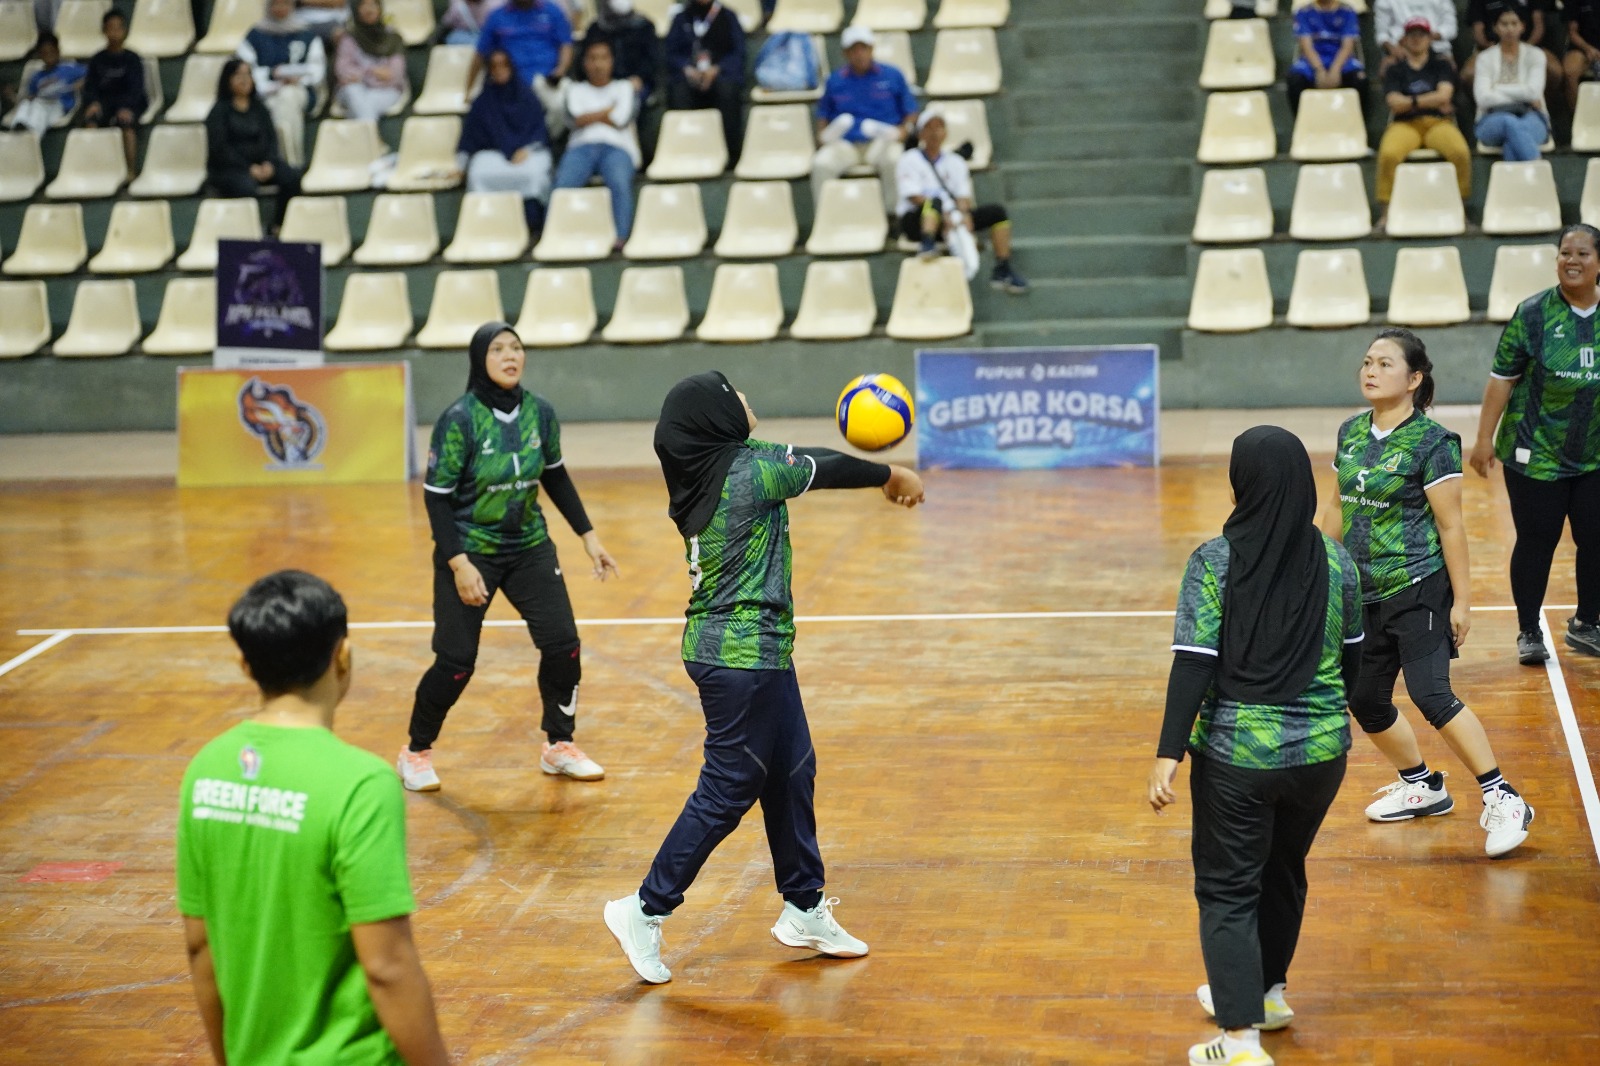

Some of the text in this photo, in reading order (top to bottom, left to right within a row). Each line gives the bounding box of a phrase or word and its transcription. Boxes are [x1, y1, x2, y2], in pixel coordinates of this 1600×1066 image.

[1580, 346, 1595, 368] 10
[1555, 370, 1582, 379] PUPUK
[928, 390, 1041, 427] GEBYAR
[1046, 390, 1144, 425] KORSA
[997, 416, 1075, 445] 2024
[1355, 469, 1370, 492] 5
[247, 785, 308, 821] FORCE
